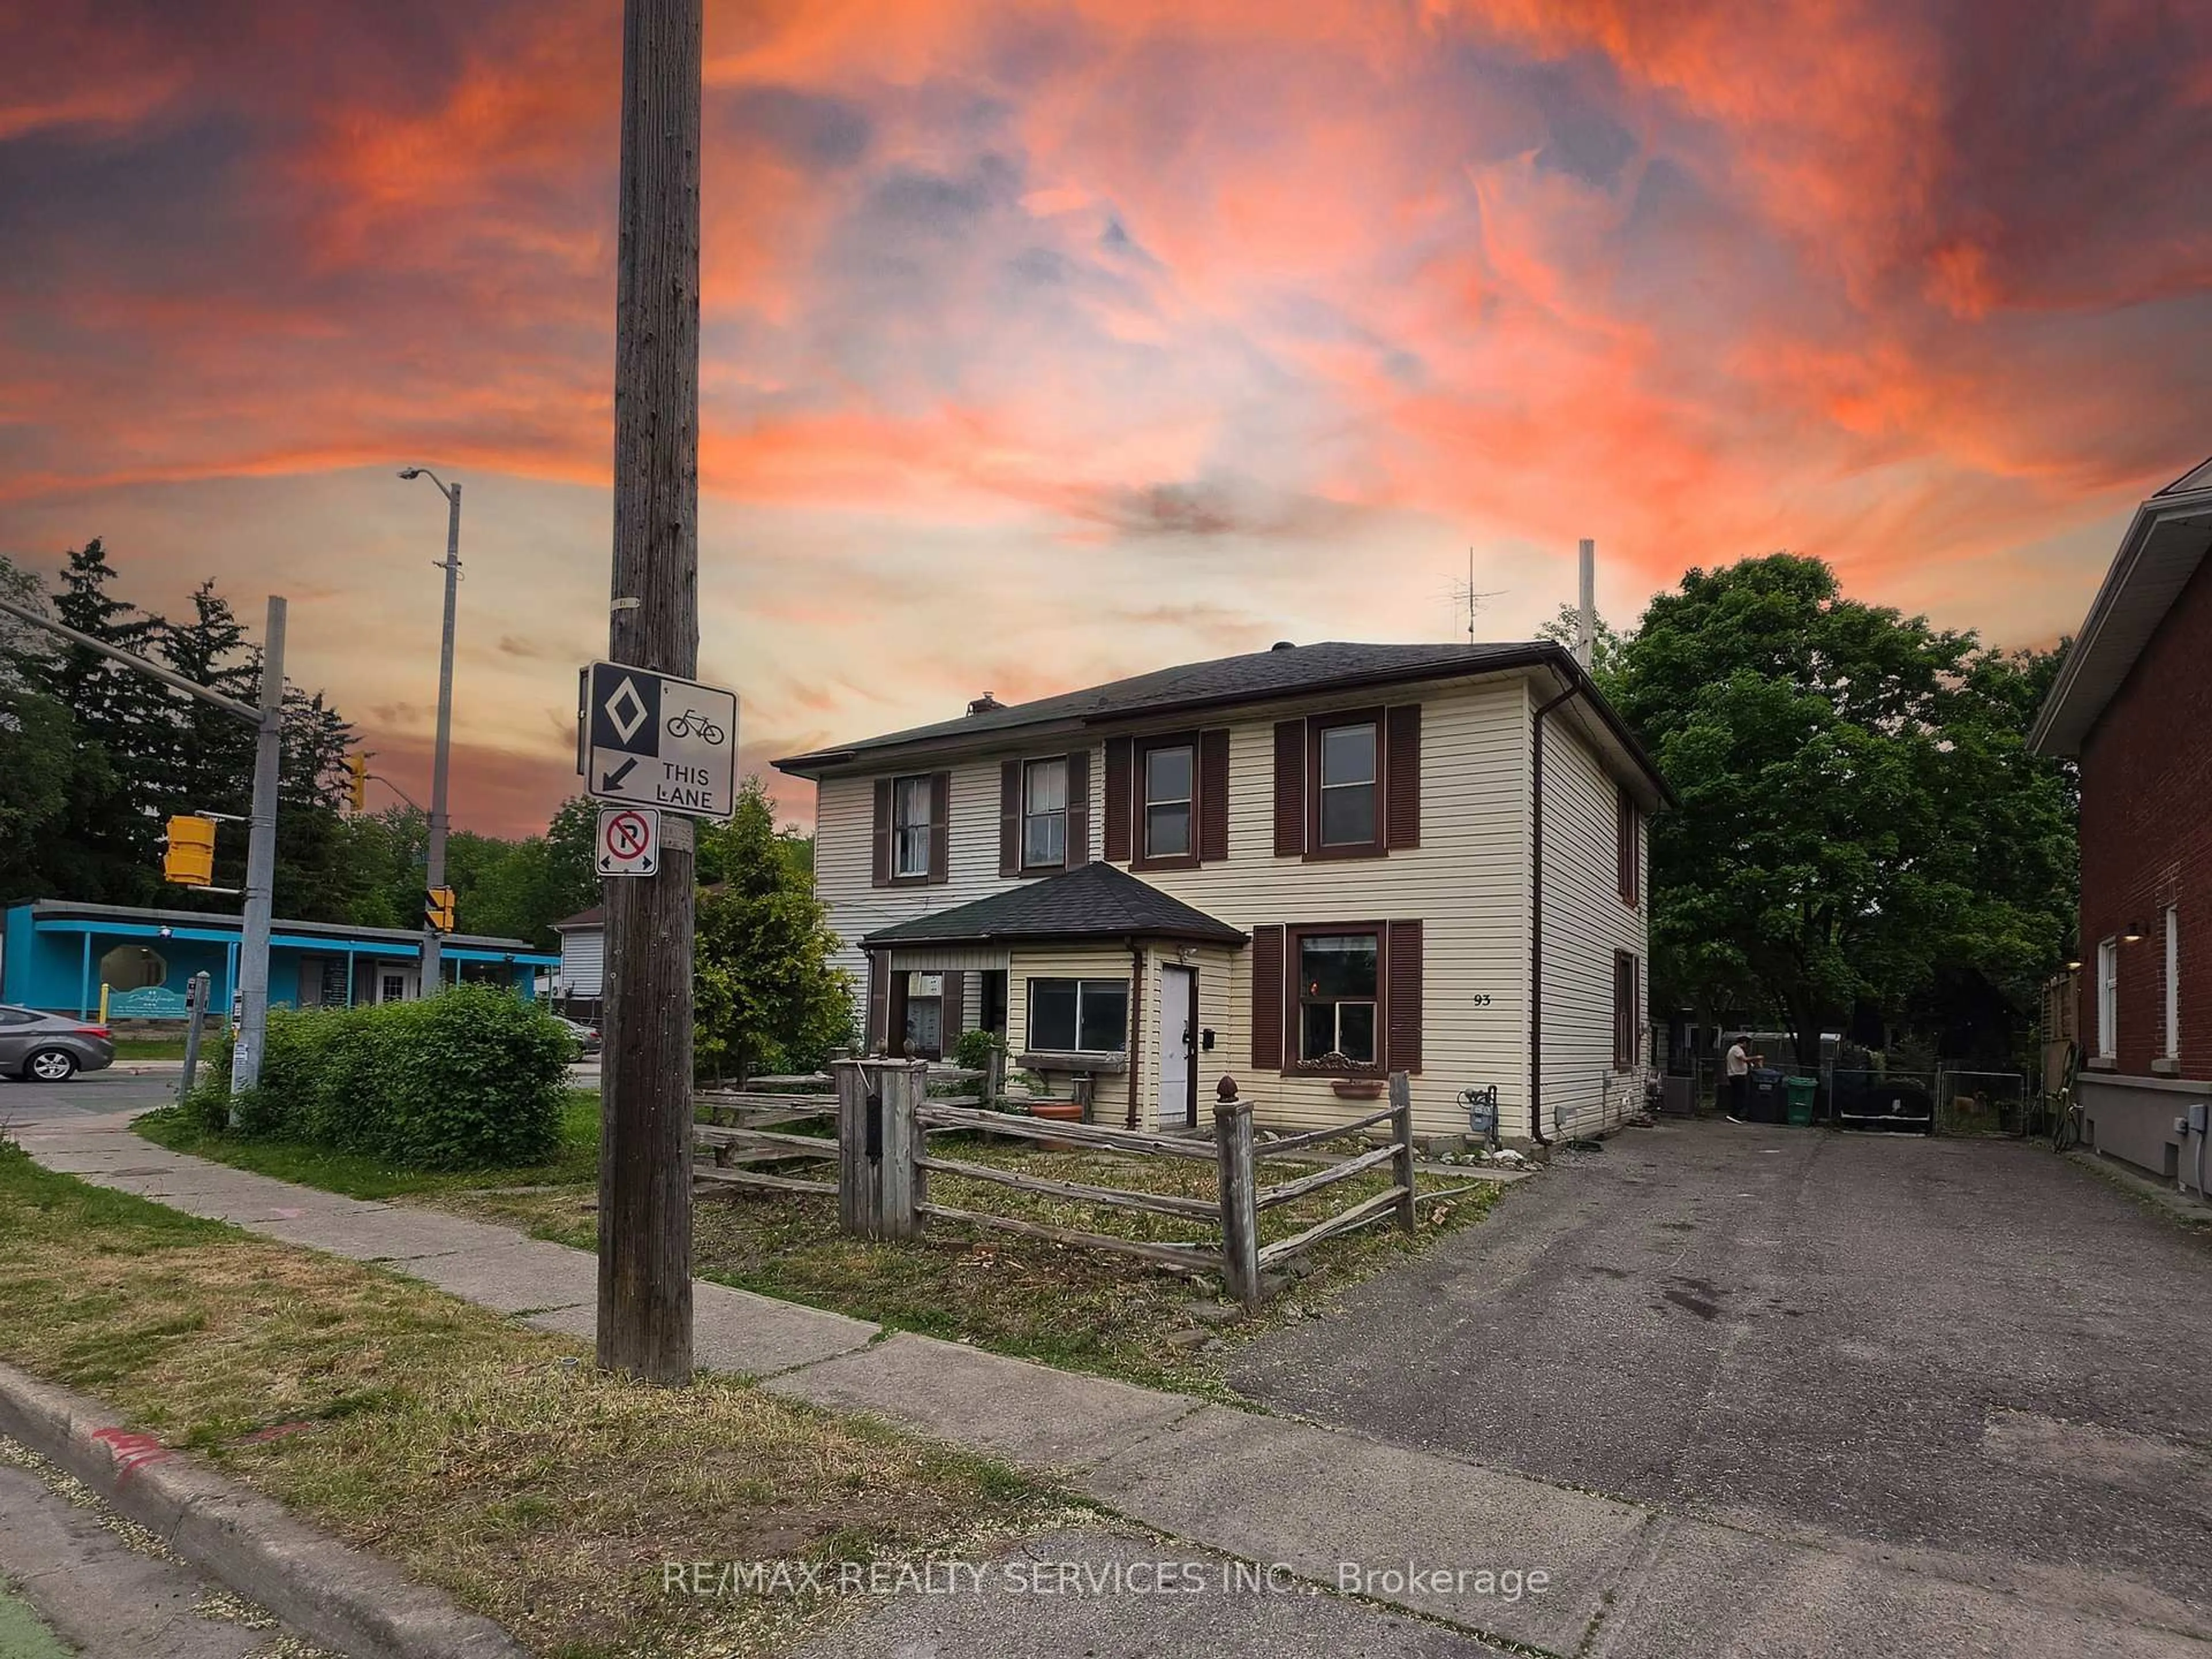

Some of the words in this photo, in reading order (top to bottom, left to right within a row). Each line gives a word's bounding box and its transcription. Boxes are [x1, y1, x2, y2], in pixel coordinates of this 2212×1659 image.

[663, 762, 709, 786] THIS
[657, 784, 712, 809] LANE
[1474, 994, 1491, 1006] 93
